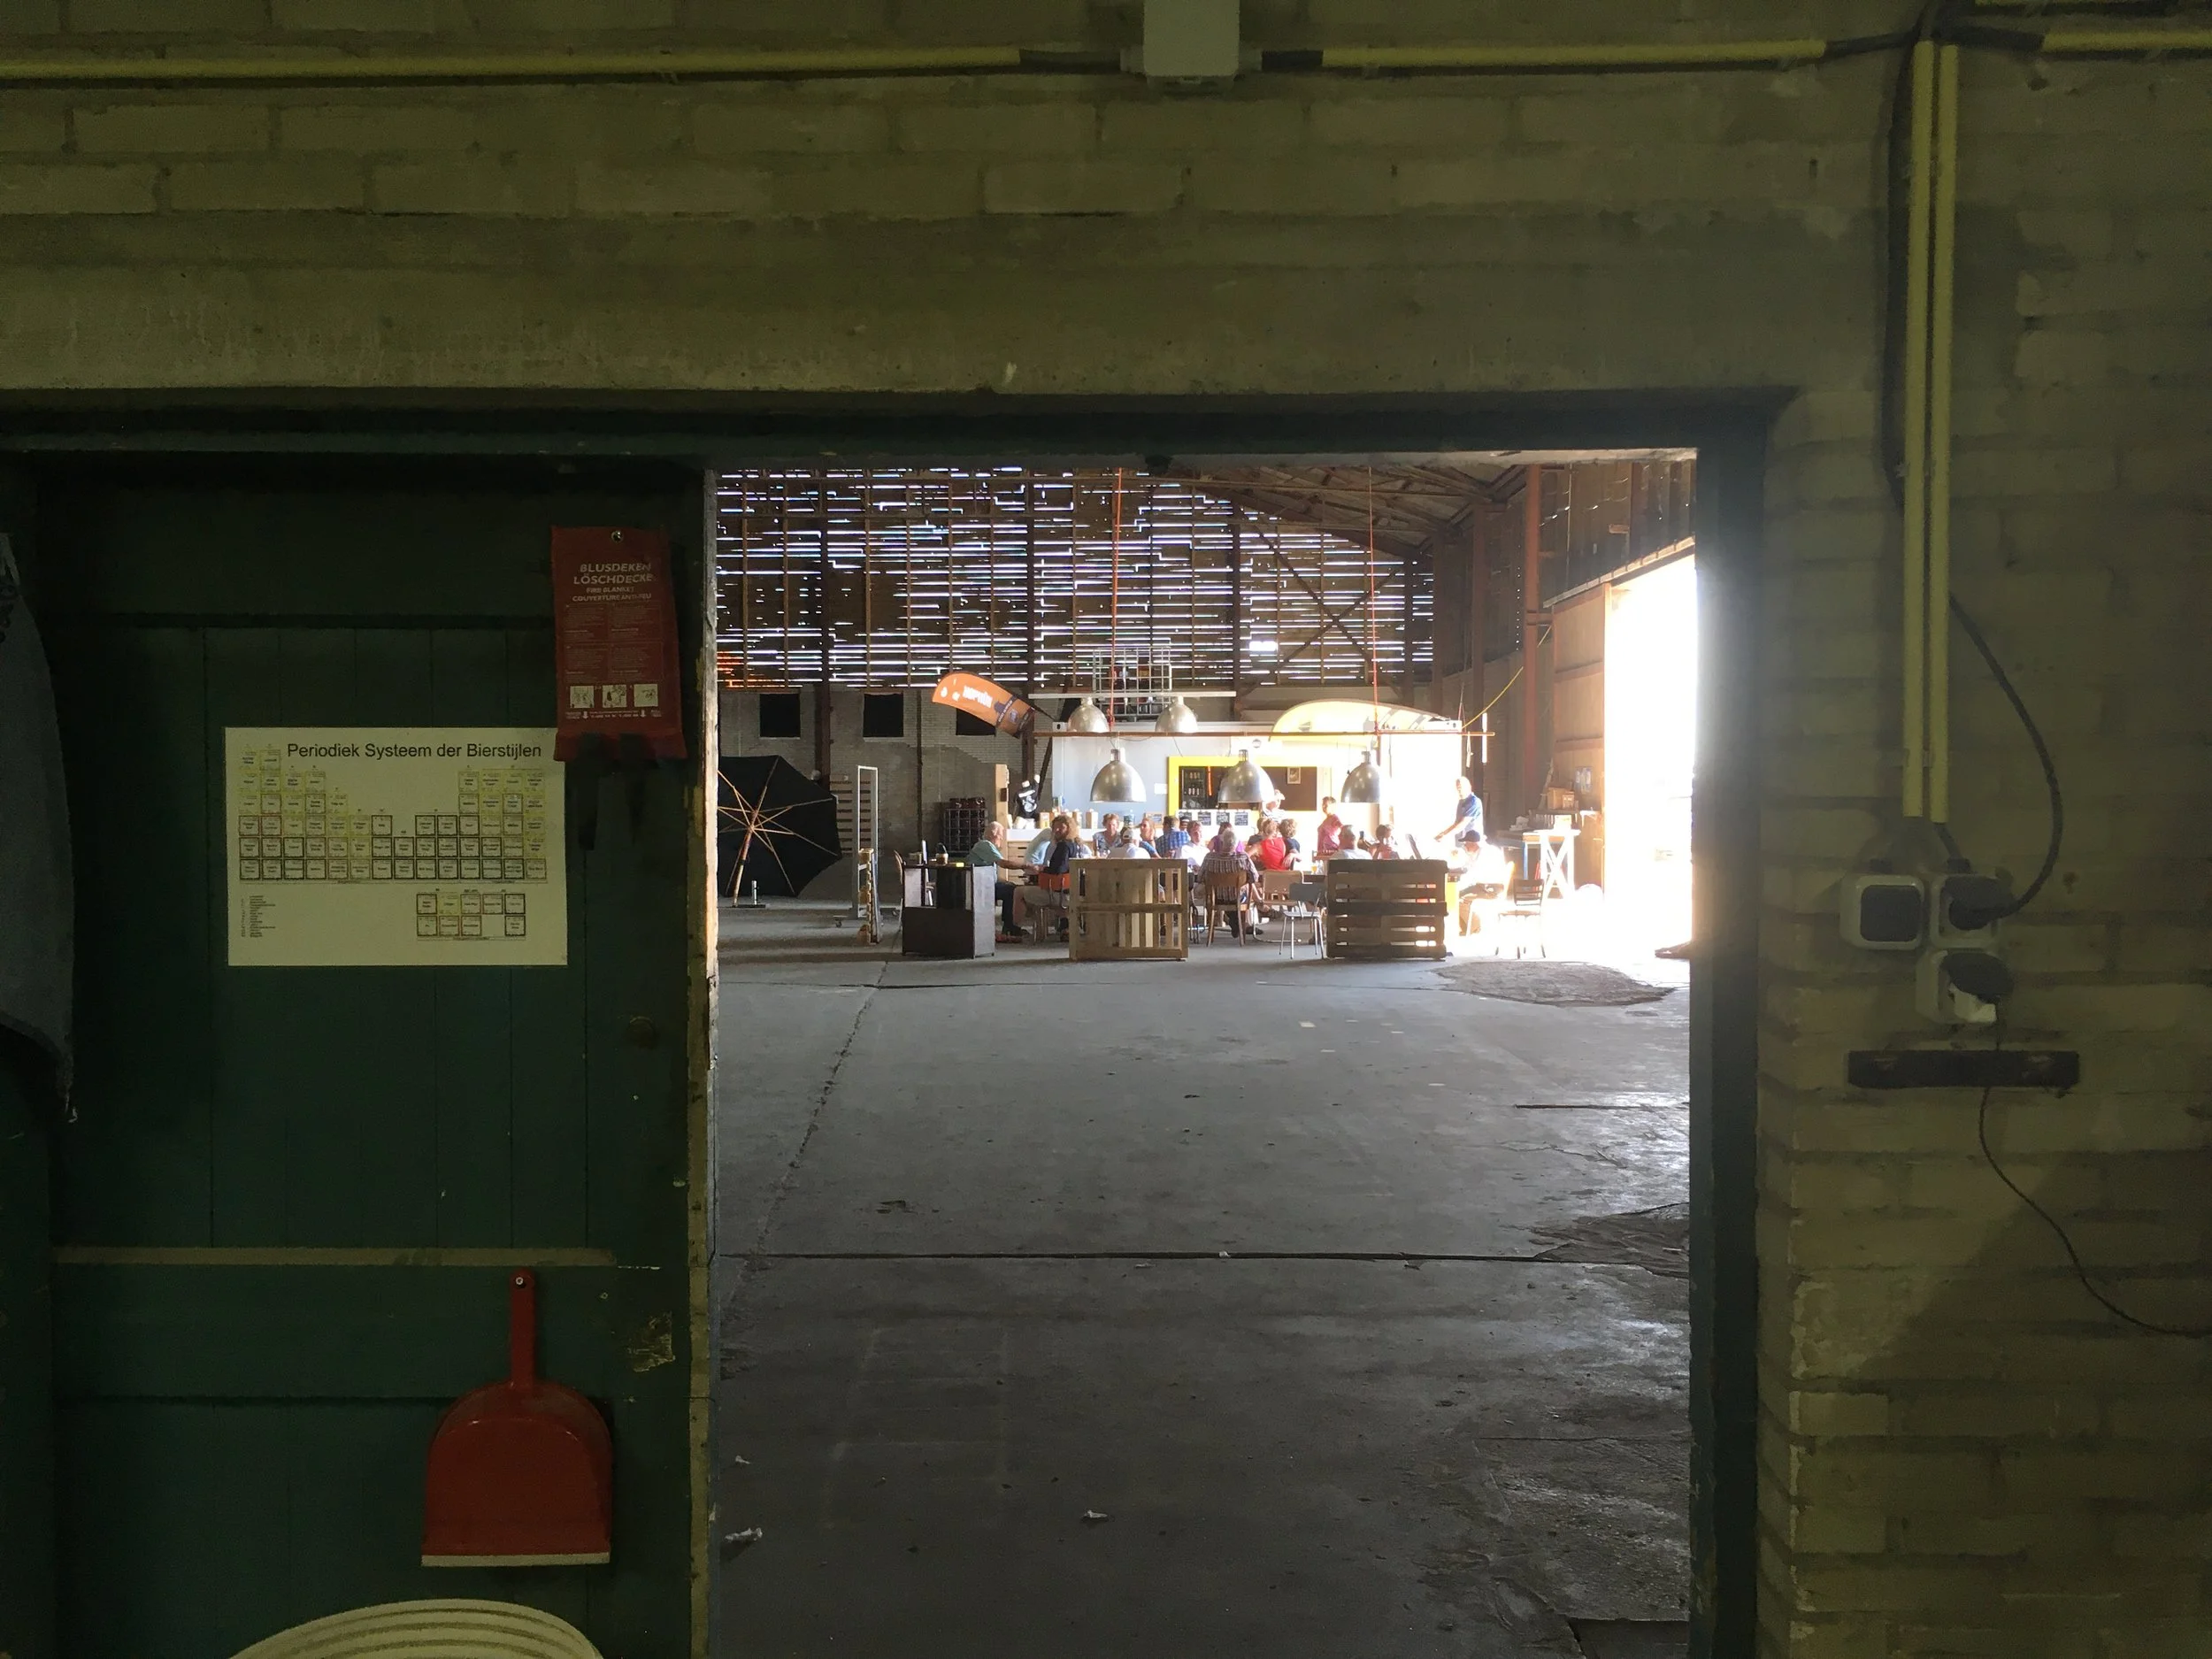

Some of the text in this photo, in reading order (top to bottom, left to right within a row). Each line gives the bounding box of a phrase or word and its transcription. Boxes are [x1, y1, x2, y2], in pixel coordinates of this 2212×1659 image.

[580, 562, 651, 572] BLUSDEKEN
[573, 572, 653, 585] LÖSCHDECKE
[288, 743, 542, 762] Periodiek Systeem der Bierstijlen
